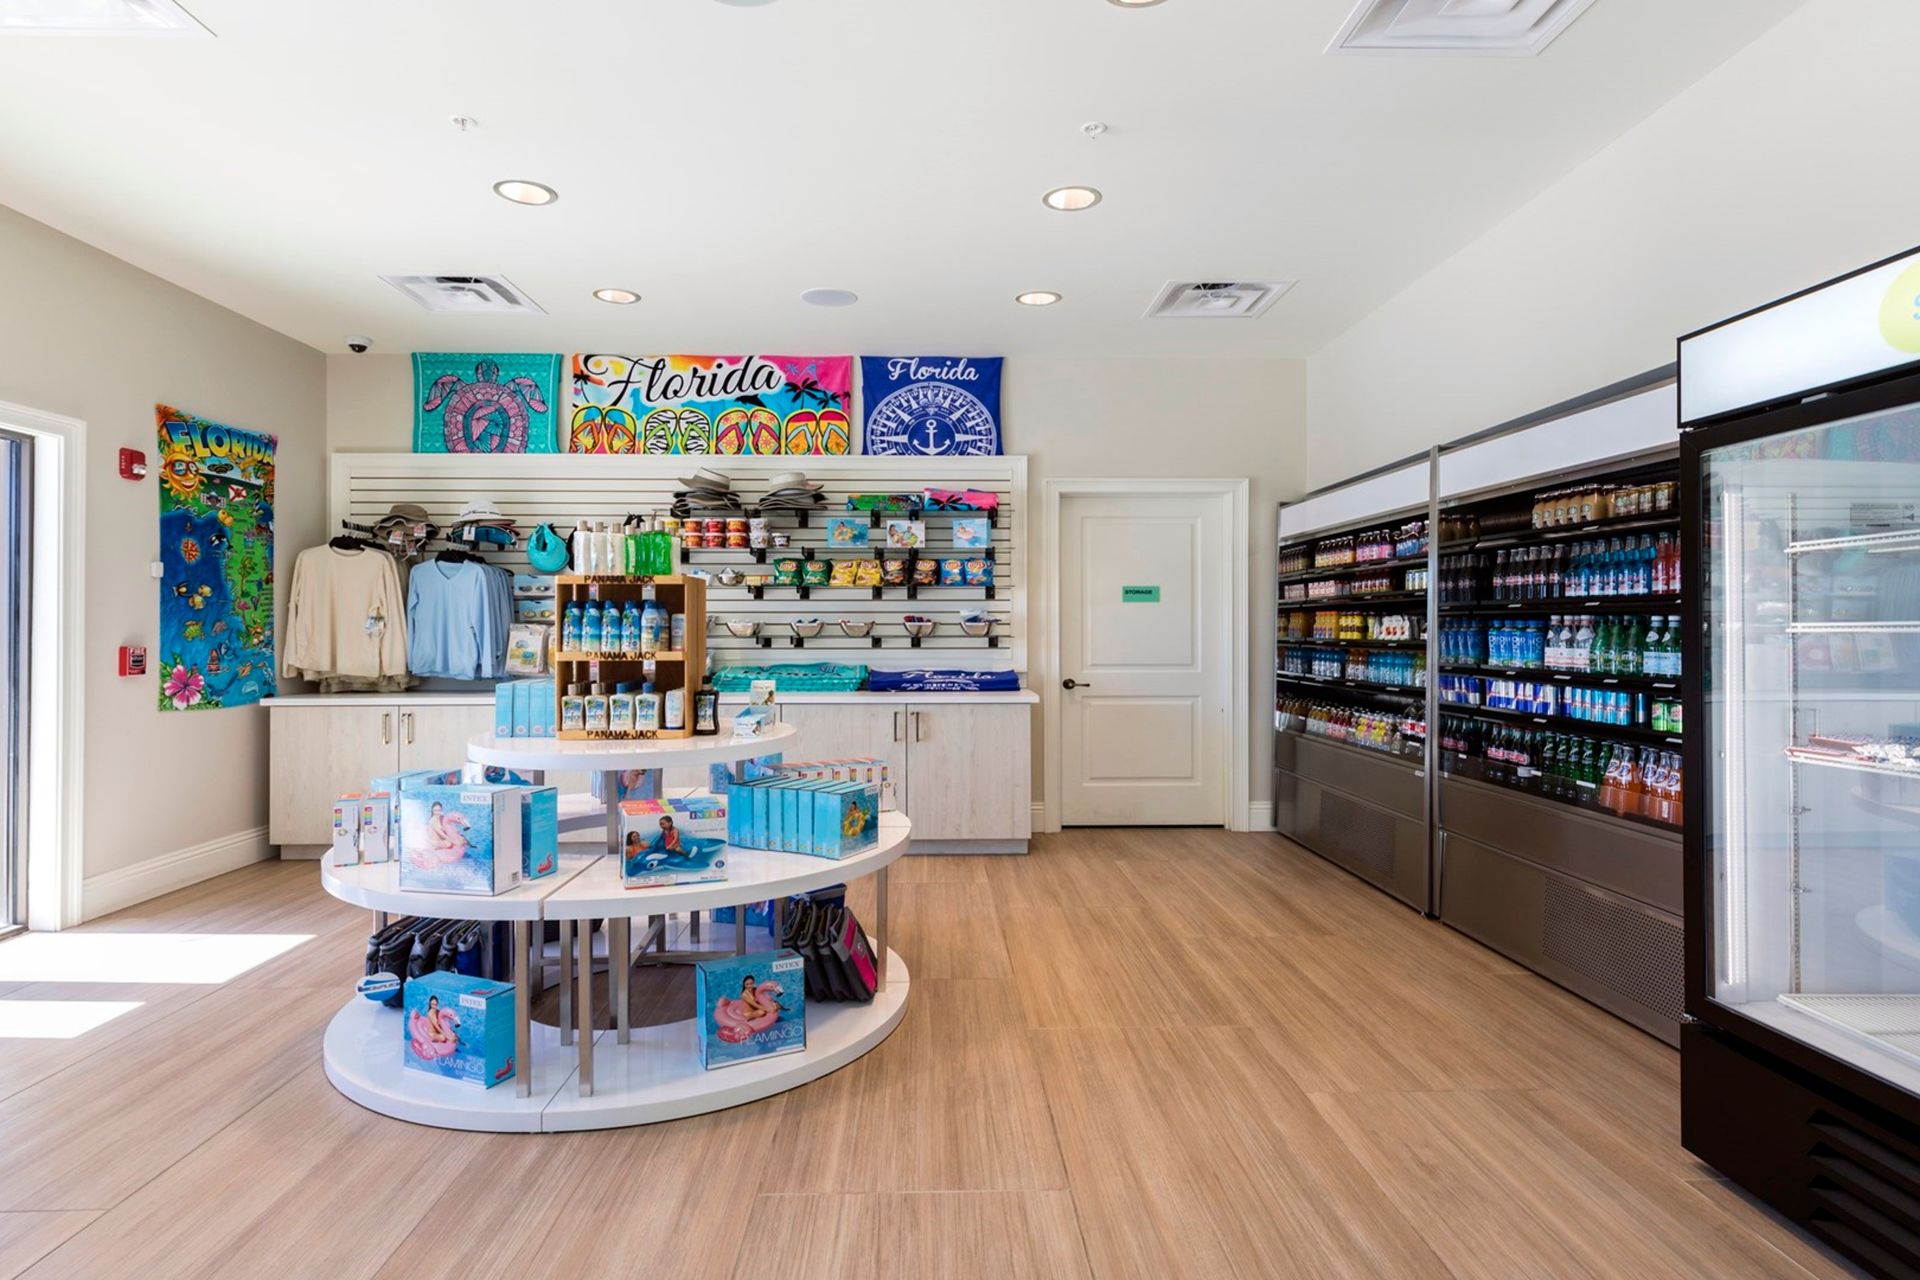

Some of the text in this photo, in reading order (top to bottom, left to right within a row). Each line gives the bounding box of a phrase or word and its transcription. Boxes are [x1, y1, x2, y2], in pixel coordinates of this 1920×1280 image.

[887, 357, 979, 381] Florida
[583, 354, 781, 406] Florida
[164, 421, 273, 463] FLORIDA
[583, 575, 656, 584] PANAMA JACK
[585, 651, 657, 660] PANAMA JACK
[586, 730, 658, 740] PANAMA JACK
[775, 961, 800, 970] INTEX
[740, 1025, 803, 1045] FLAMINGO
